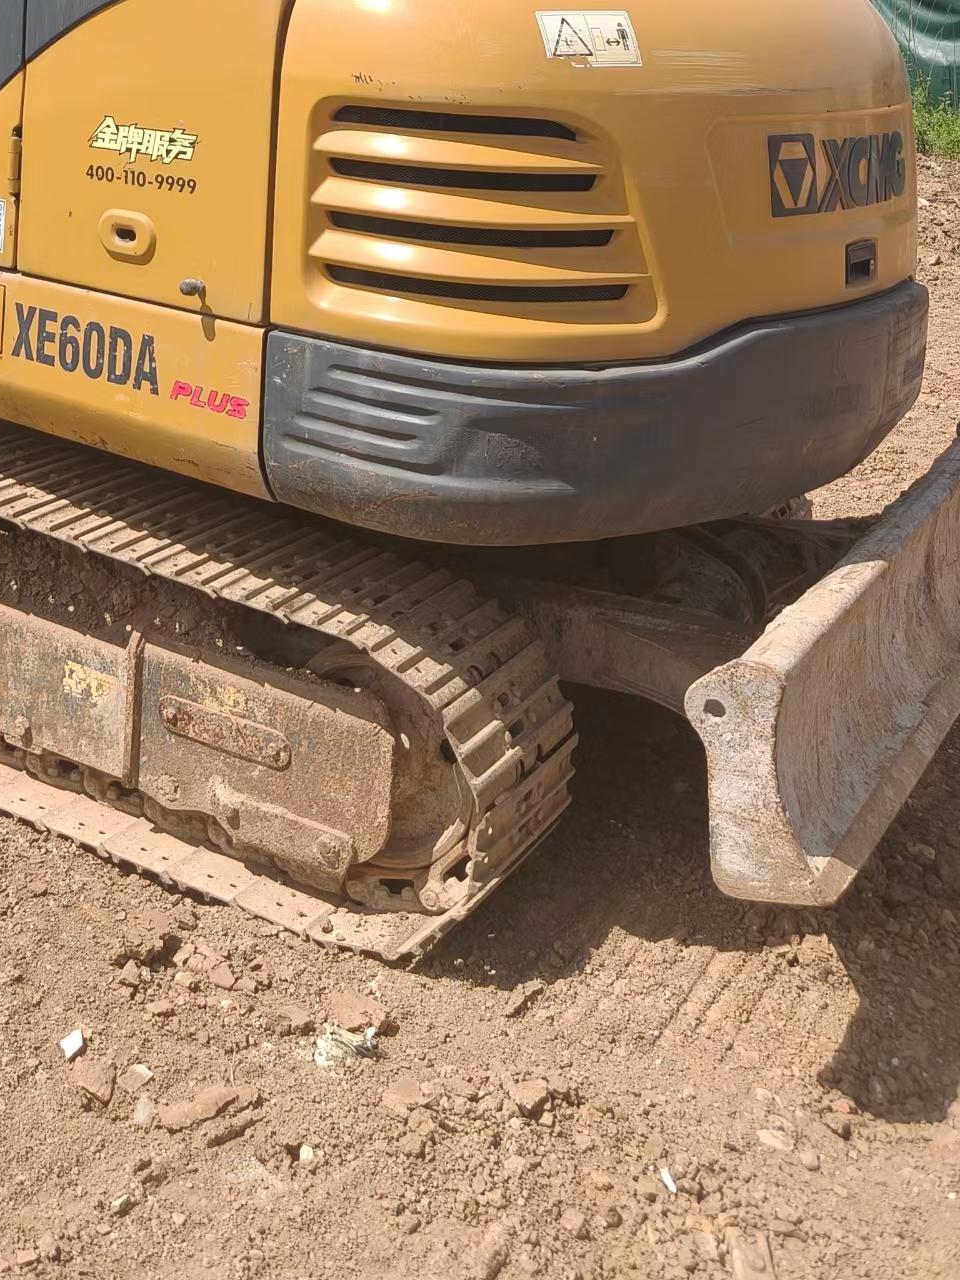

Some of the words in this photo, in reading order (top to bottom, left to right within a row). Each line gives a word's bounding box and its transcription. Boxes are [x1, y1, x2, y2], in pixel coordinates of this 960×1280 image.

[87, 115, 199, 164] 金牌服务
[817, 131, 906, 214] XCMG
[85, 164, 197, 195] 400-110-9999
[11, 302, 159, 396] XE60DA
[170, 380, 250, 419] PLUS
